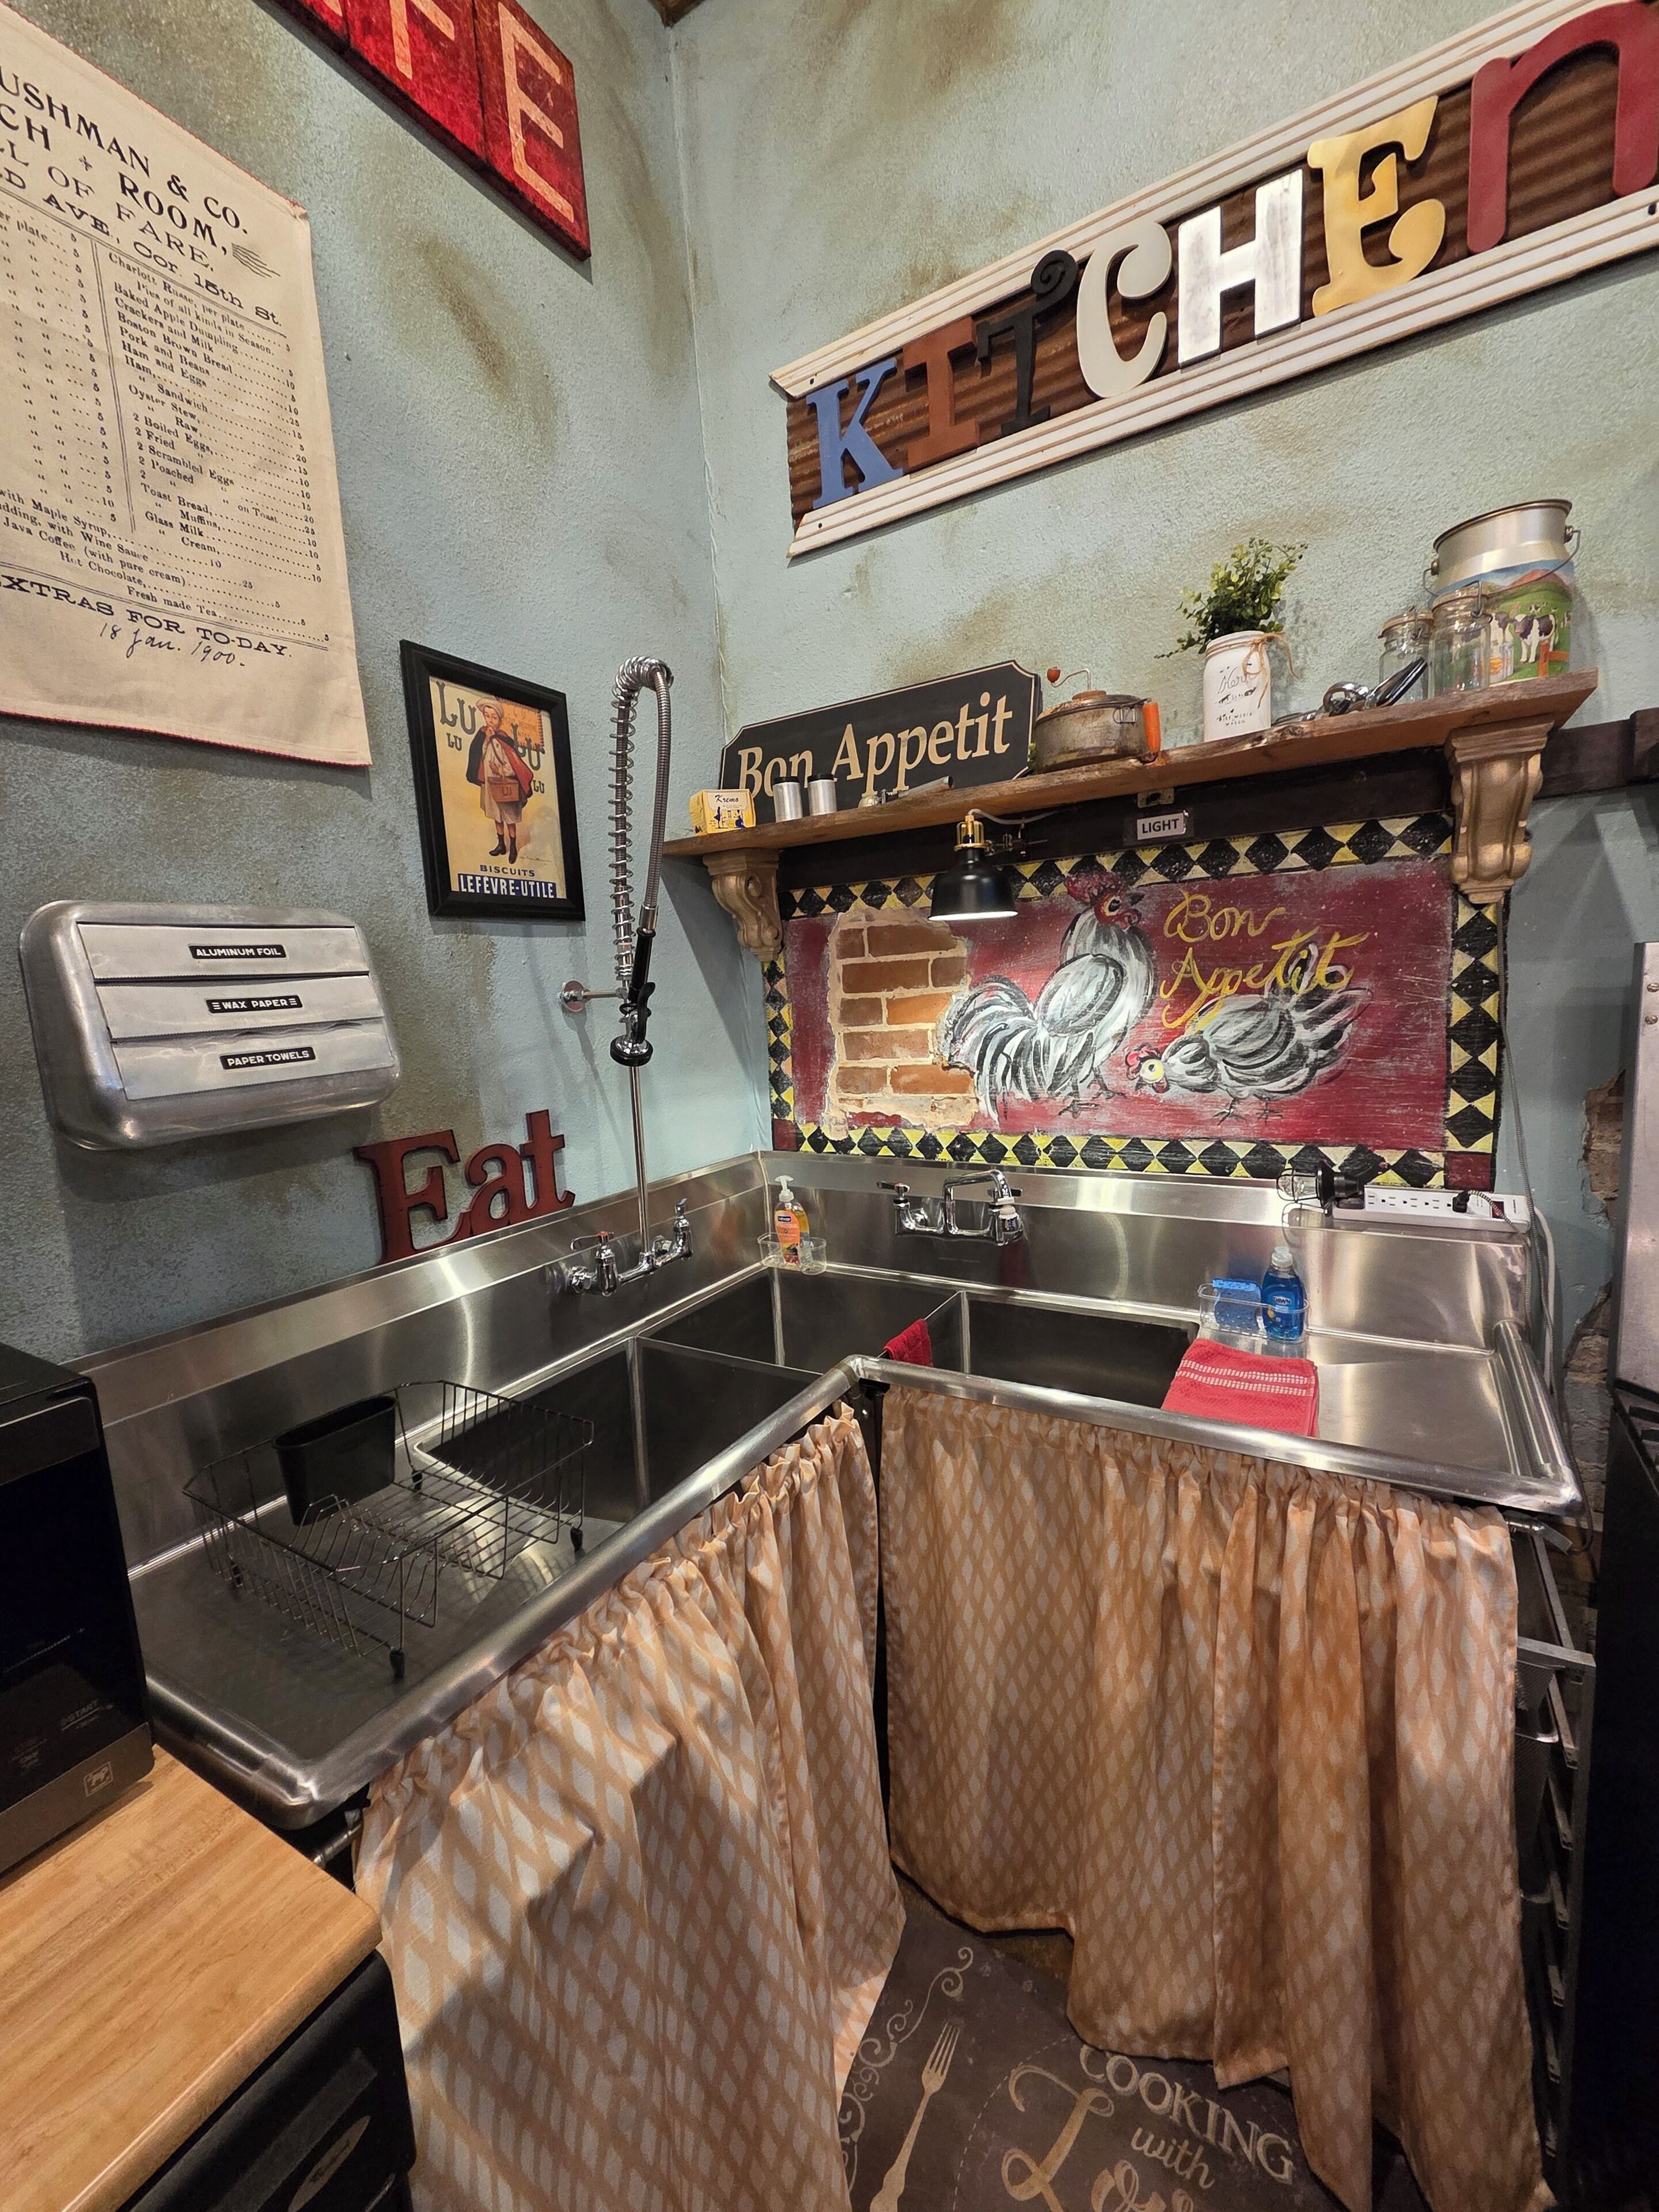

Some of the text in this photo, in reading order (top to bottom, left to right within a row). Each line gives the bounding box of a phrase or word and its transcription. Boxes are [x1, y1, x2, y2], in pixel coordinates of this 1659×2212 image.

[48, 166, 95, 198] OF
[116, 202, 214, 271] FARE.
[118, 172, 227, 255] ROOM,
[167, 175, 190, 203] &
[204, 196, 248, 234] CO.
[17, 221, 47, 243] plate
[115, 282, 149, 308] Baked
[154, 304, 185, 326] Apple
[190, 321, 238, 354] Dumpling
[194, 273, 244, 309] 15th
[255, 306, 282, 327] St.
[202, 304, 218, 316] per
[222, 312, 244, 331] plate
[115, 297, 295, 390] Crackers and Milk 10
[118, 311, 156, 338] Boston
[162, 334, 198, 357] Brown
[203, 353, 232, 374] Bread
[164, 298, 174, 307] of
[179, 305, 191, 316] all
[225, 326, 234, 338] in
[238, 333, 274, 355] Season.
[119, 326, 298, 415] Pork and Beans 10
[122, 340, 149, 361] Ham
[156, 359, 175, 373] and
[181, 368, 207, 387] Eggs
[124, 354, 156, 378] Ham,
[157, 384, 208, 412] Sandwich
[128, 384, 306, 463] Oyster Stew, 20
[175, 416, 202, 437] Raw,
[133, 412, 309, 487] 2 Boiled Eggs, 10
[135, 427, 310, 499] 2 Fried 10
[137, 442, 143, 450] 2
[149, 445, 203, 475] Scrambled
[209, 469, 234, 486] Eggs
[103, 497, 114, 507] 10
[139, 456, 314, 524] 2 Poached 20
[140, 470, 146, 479] 2
[237, 505, 249, 513] on
[32, 499, 68, 521] Maple
[74, 516, 111, 538] Syrup,
[210, 559, 222, 568] 10
[111, 514, 116, 522] 5
[140, 483, 317, 547] Toast Bread, 10
[145, 511, 173, 528] Glass
[179, 522, 204, 537] Milk
[180, 510, 319, 559] Muffins, 10
[3, 517, 33, 535] Java
[39, 531, 75, 551] Coffee
[84, 547, 113, 563] (with
[120, 560, 143, 573] pure
[149, 569, 185, 586] cream)
[48, 522, 73, 536] with
[81, 531, 112, 550] Wine
[117, 544, 149, 562] Sauce
[181, 536, 321, 583] Cream, 10
[88, 560, 146, 589] Chocolate,
[0, 574, 291, 657] XTRAS FOR TO-DAY.
[127, 585, 158, 603] Fresh
[163, 599, 192, 611] made
[196, 605, 217, 617] Tea
[99, 623, 122, 639] 18
[435, 681, 476, 734] LU
[446, 733, 462, 751] LU
[831, 691, 1013, 797] Appetit
[533, 780, 544, 794] LU
[715, 794, 738, 802] Kremo
[1142, 819, 1179, 834] LIGHT
[480, 865, 535, 877] BISCUITS
[1164, 889, 1286, 942] Bon
[222, 999, 288, 1009] WAX PAPER
[227, 1051, 309, 1066] PAPER TOWELS
[353, 1109, 575, 1267] Eat
[1080, 2043, 1294, 2185] COOKING
[1131, 2127, 1215, 2189] with
